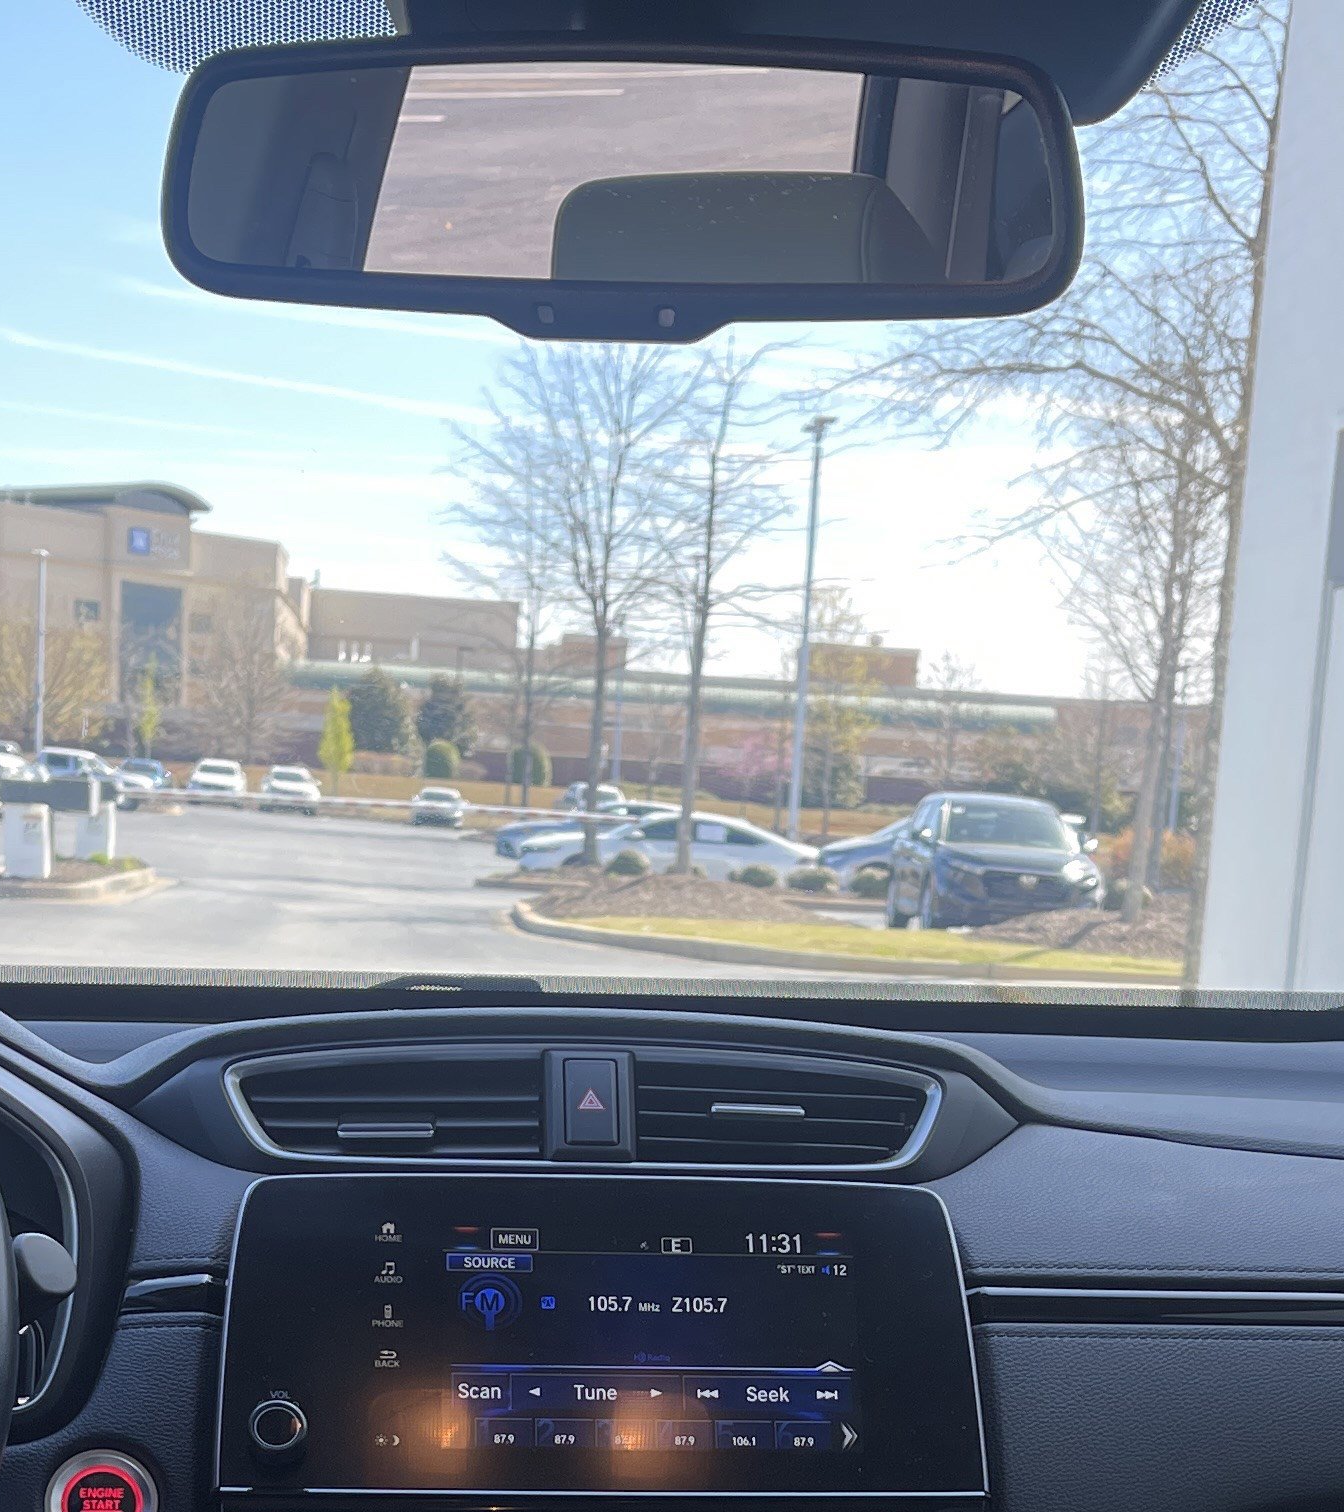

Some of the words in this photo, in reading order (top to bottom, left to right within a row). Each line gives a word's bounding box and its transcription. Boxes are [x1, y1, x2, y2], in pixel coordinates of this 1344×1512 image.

[374, 1235, 403, 1243] HOME
[498, 1234, 532, 1245] MENU
[745, 1233, 802, 1254] 11:31
[463, 1257, 516, 1269] SOURCE
[833, 1264, 847, 1276] 12
[373, 1276, 403, 1284] AUDIO
[588, 1296, 633, 1312] 105.7
[638, 1303, 661, 1312] MHz
[671, 1297, 728, 1313] Z105.7
[372, 1320, 404, 1328] PHONE
[374, 1360, 401, 1368] BACK
[269, 1390, 291, 1399] VOL
[457, 1383, 502, 1399] Scan
[573, 1384, 618, 1401] Tune
[746, 1386, 790, 1403] Seek
[493, 1434, 515, 1444] 87.9
[554, 1434, 575, 1445] 87.9
[674, 1435, 696, 1446] 87.9
[732, 1436, 756, 1447] 106.1
[794, 1436, 815, 1447] 87.9
[79, 1487, 125, 1499] ENGINE
[83, 1499, 121, 1510] START
